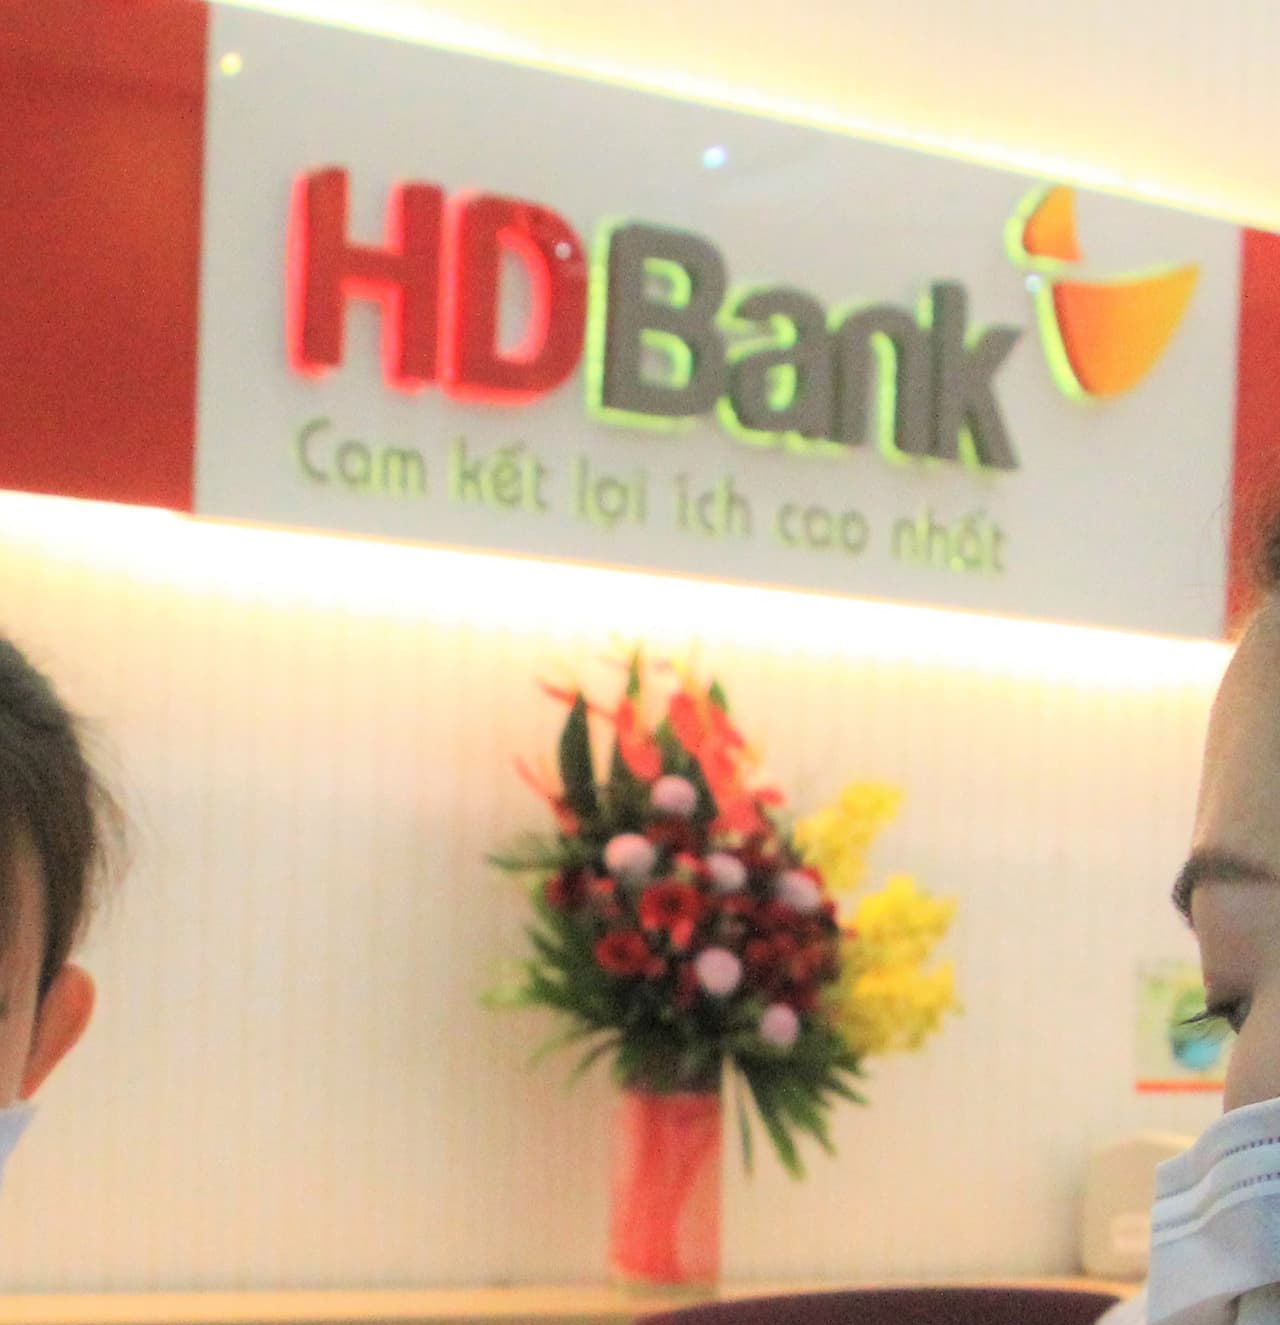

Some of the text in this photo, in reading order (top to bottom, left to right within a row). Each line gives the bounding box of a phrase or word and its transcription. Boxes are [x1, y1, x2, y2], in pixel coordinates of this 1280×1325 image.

[287, 167, 1023, 471] HDBank
[293, 416, 428, 495] Cam
[449, 434, 549, 512] kết
[772, 501, 871, 555] cao
